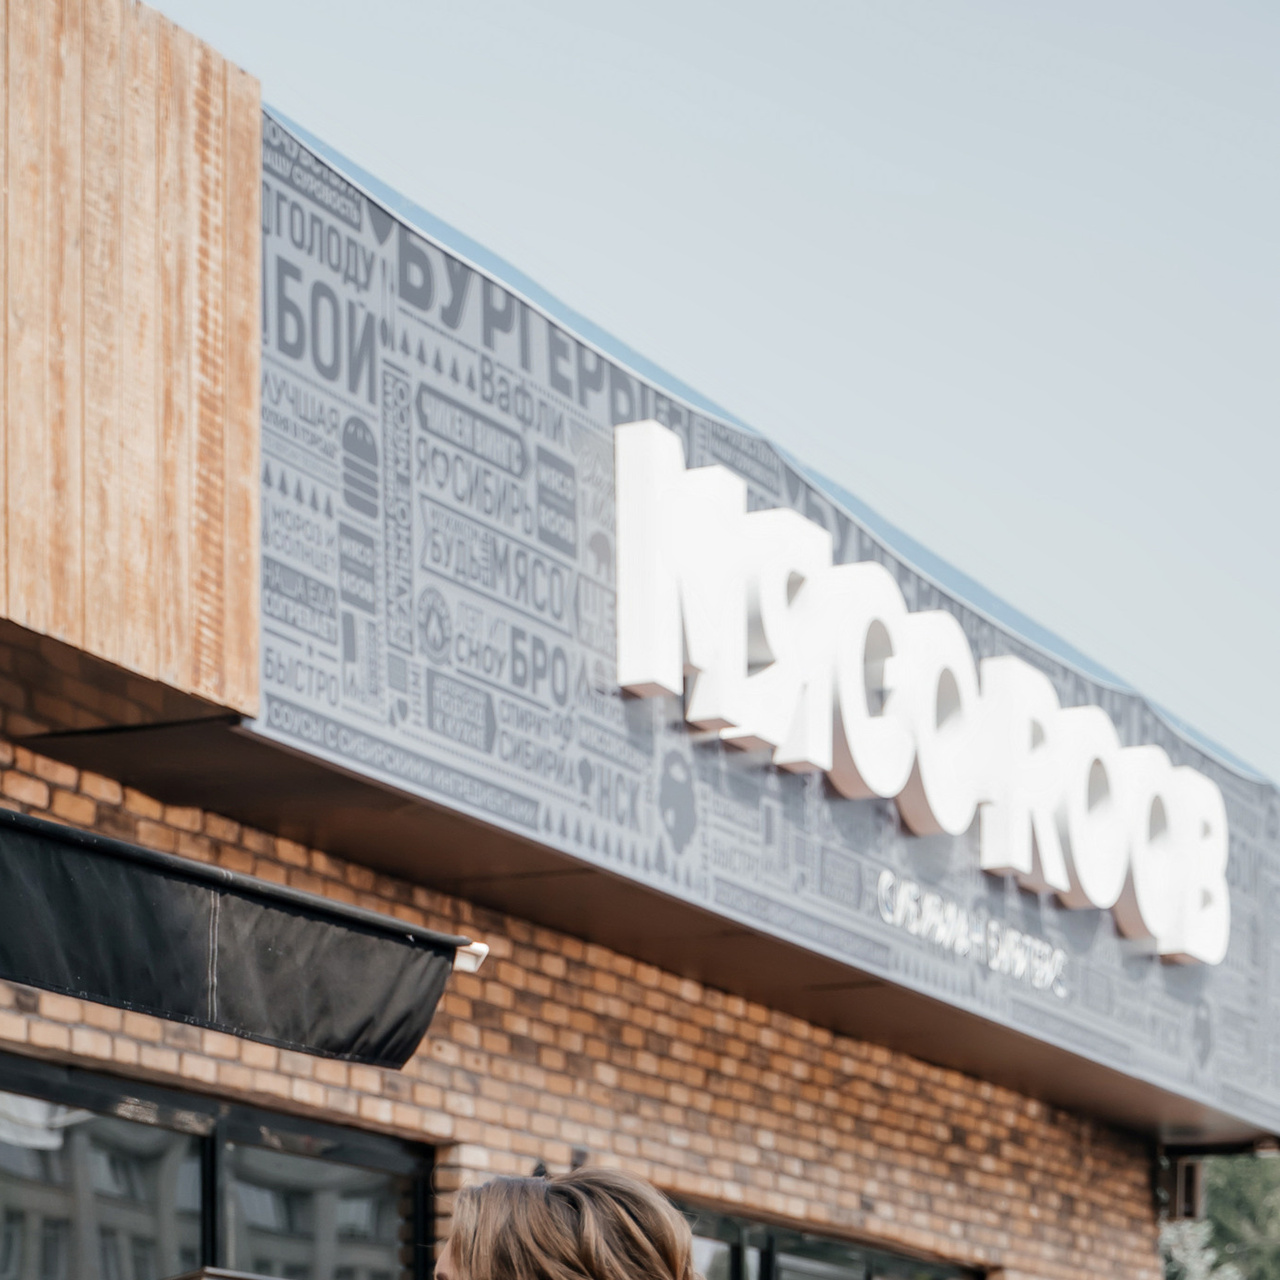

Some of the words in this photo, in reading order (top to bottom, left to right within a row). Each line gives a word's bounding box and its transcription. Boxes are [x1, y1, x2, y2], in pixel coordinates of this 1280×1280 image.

[276, 189, 375, 292] ГОЛОДУ
[276, 254, 376, 405] БОЙ
[394, 378, 412, 474] МЯСО
[481, 353, 567, 447] Вафли
[453, 452, 533, 535] СИБИРЬ
[492, 536, 565, 621] МЯСО
[264, 647, 340, 707] БЫСТРО
[455, 632, 507, 680] СНОУ
[510, 624, 569, 707] БРО
